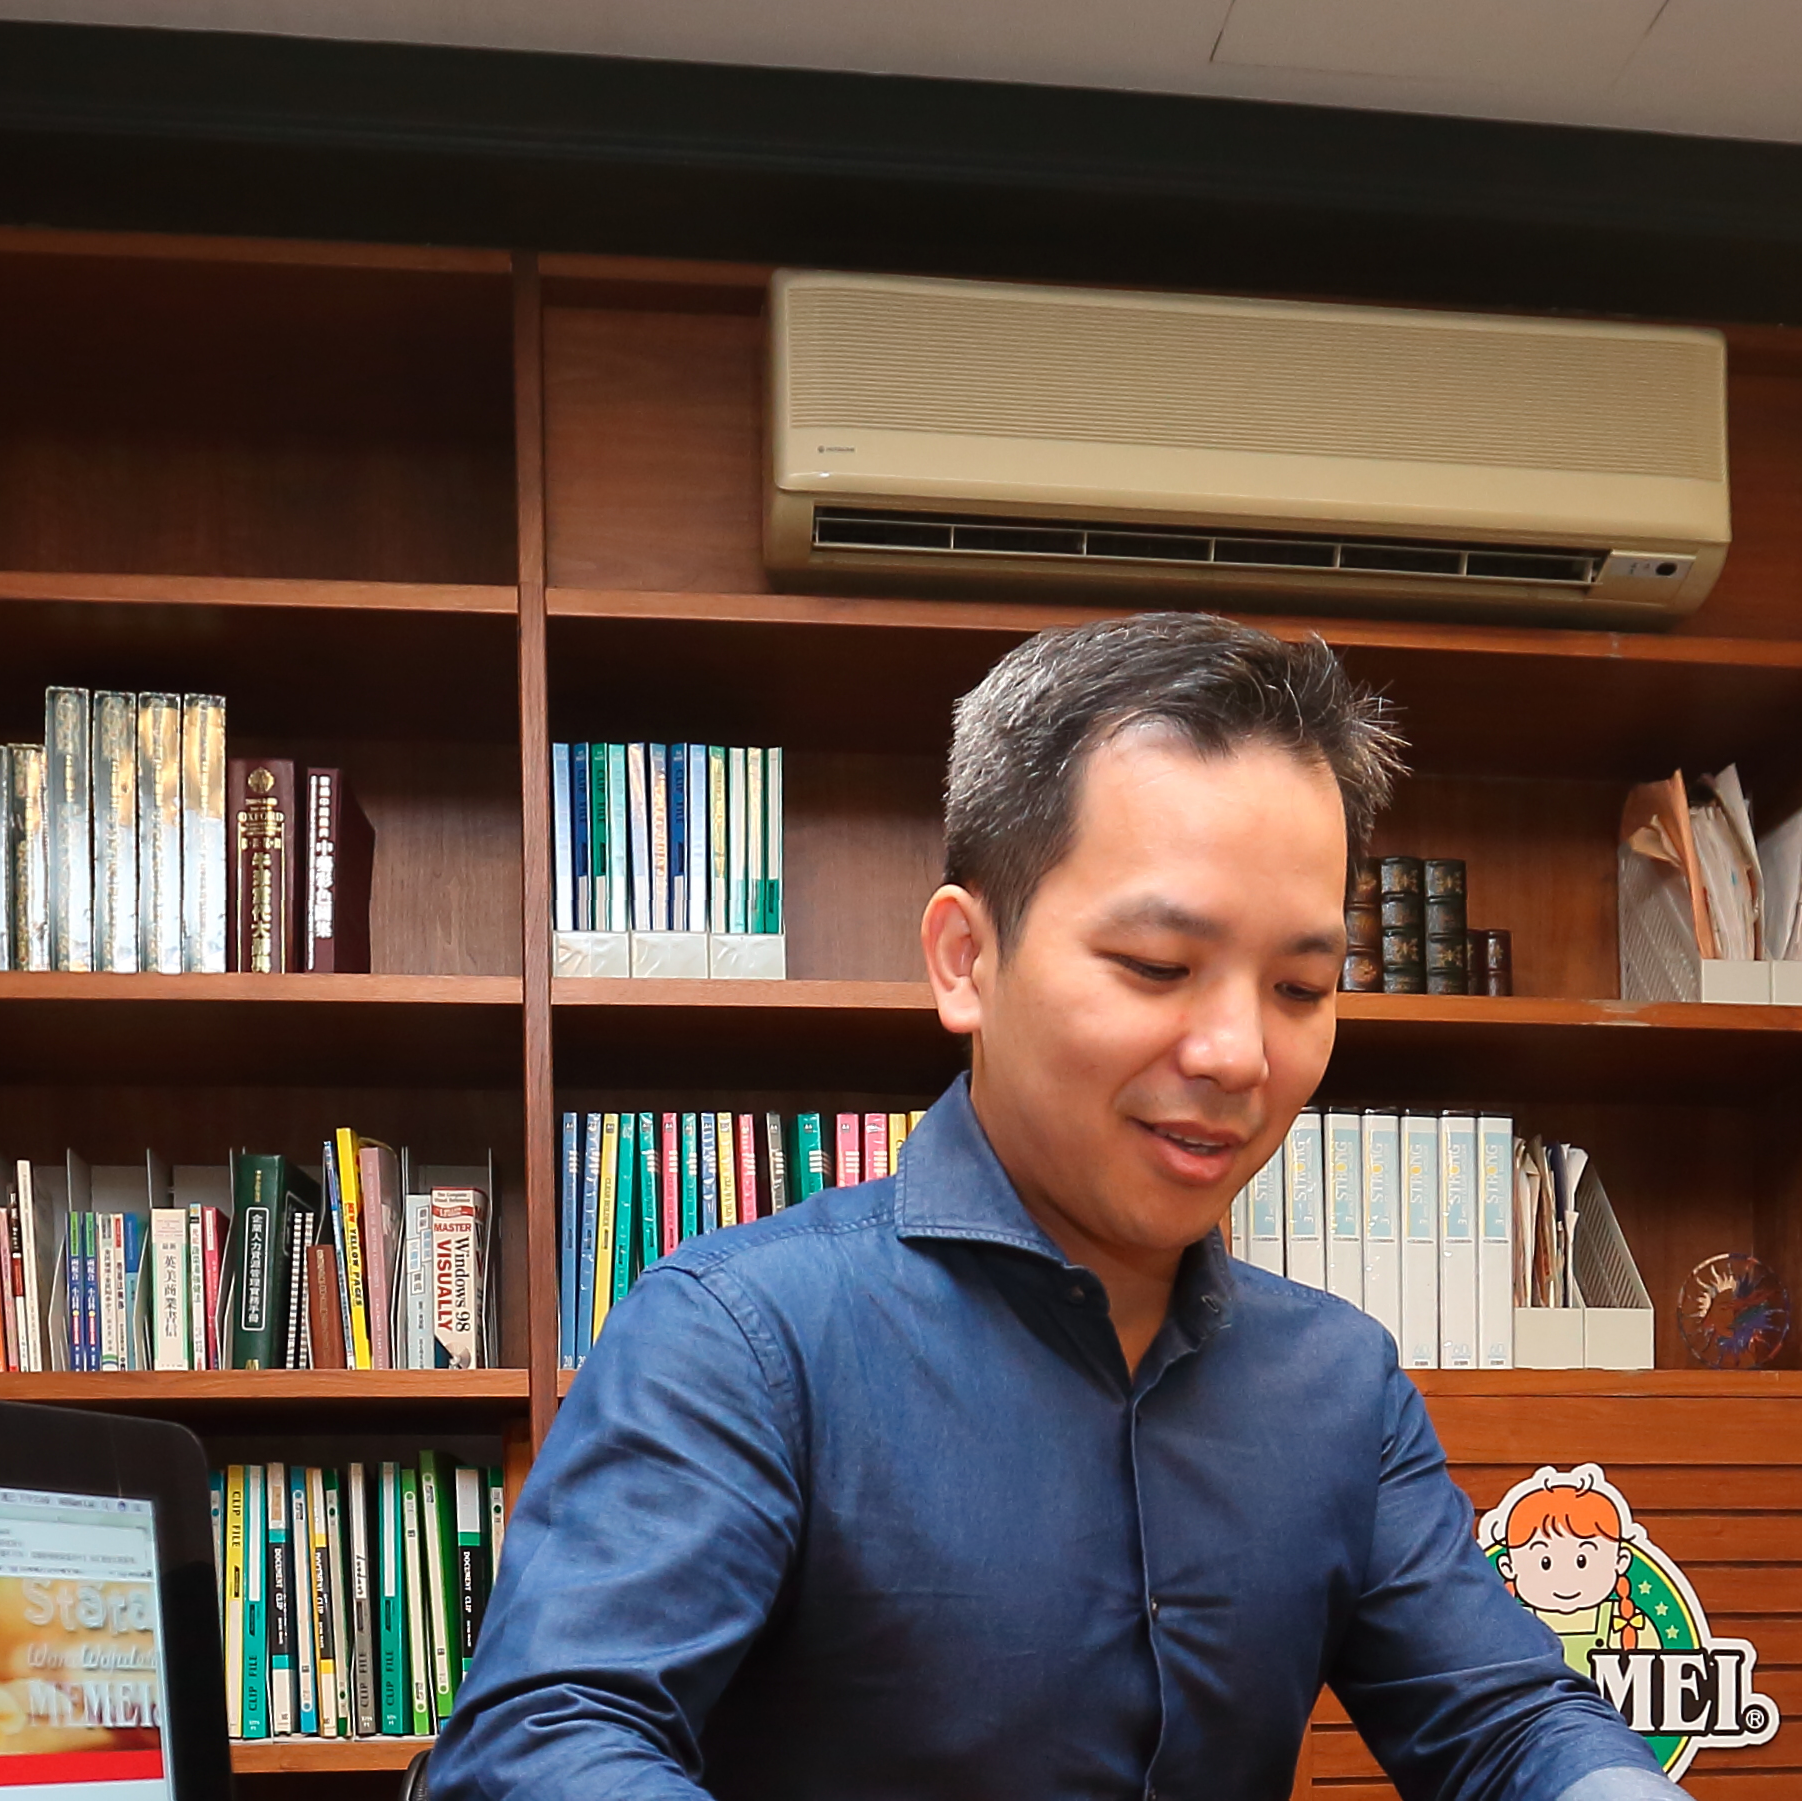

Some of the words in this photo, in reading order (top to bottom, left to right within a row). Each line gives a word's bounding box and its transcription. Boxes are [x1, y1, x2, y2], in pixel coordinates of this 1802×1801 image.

[237, 812, 284, 822] OXFORD
[1294, 1141, 1305, 1202] STRONG
[1336, 1140, 1347, 1202] STRONG
[1372, 1142, 1383, 1203] STRONG
[1411, 1143, 1422, 1205] STRONG
[1449, 1142, 1460, 1205] STRONG
[1486, 1143, 1498, 1205] STRONG
[434, 1223, 471, 1232] MASTER
[351, 1228, 360, 1268] YELLOW
[455, 1236, 470, 1308] Windows
[354, 1271, 364, 1306] PAGES
[437, 1239, 452, 1332] VISUALLY
[456, 1311, 470, 1333] 98
[232, 1490, 241, 1516] CLIP
[232, 1524, 241, 1548] FILE
[276, 1593, 284, 1611] CLIP
[464, 1596, 472, 1613] CLIP
[249, 1655, 257, 1677] FILE
[386, 1651, 394, 1673] FILE
[249, 1686, 257, 1711] CLIP
[361, 1683, 369, 1708] CLIP
[386, 1681, 394, 1706] CLIP
[1592, 1653, 1741, 1732] MEI
